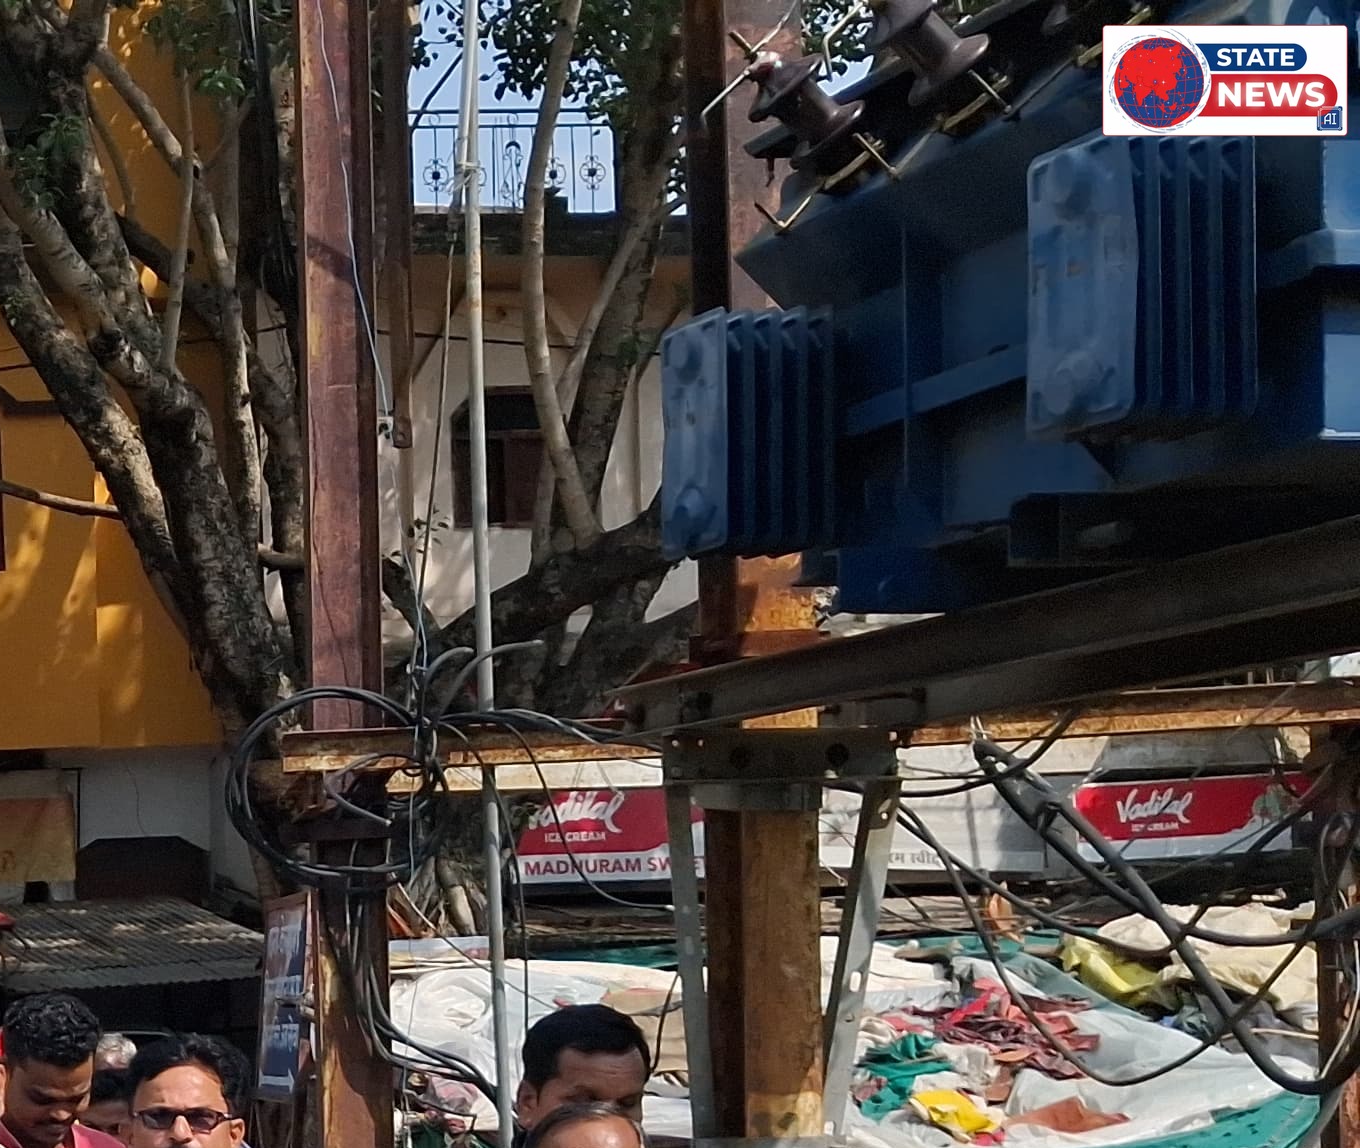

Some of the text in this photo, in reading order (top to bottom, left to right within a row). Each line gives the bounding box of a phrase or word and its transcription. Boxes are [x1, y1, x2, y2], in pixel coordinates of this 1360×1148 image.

[1116, 787, 1194, 823] Vadilal
[545, 831, 606, 843] ICE CREAM
[524, 858, 642, 876] MADHURAM
